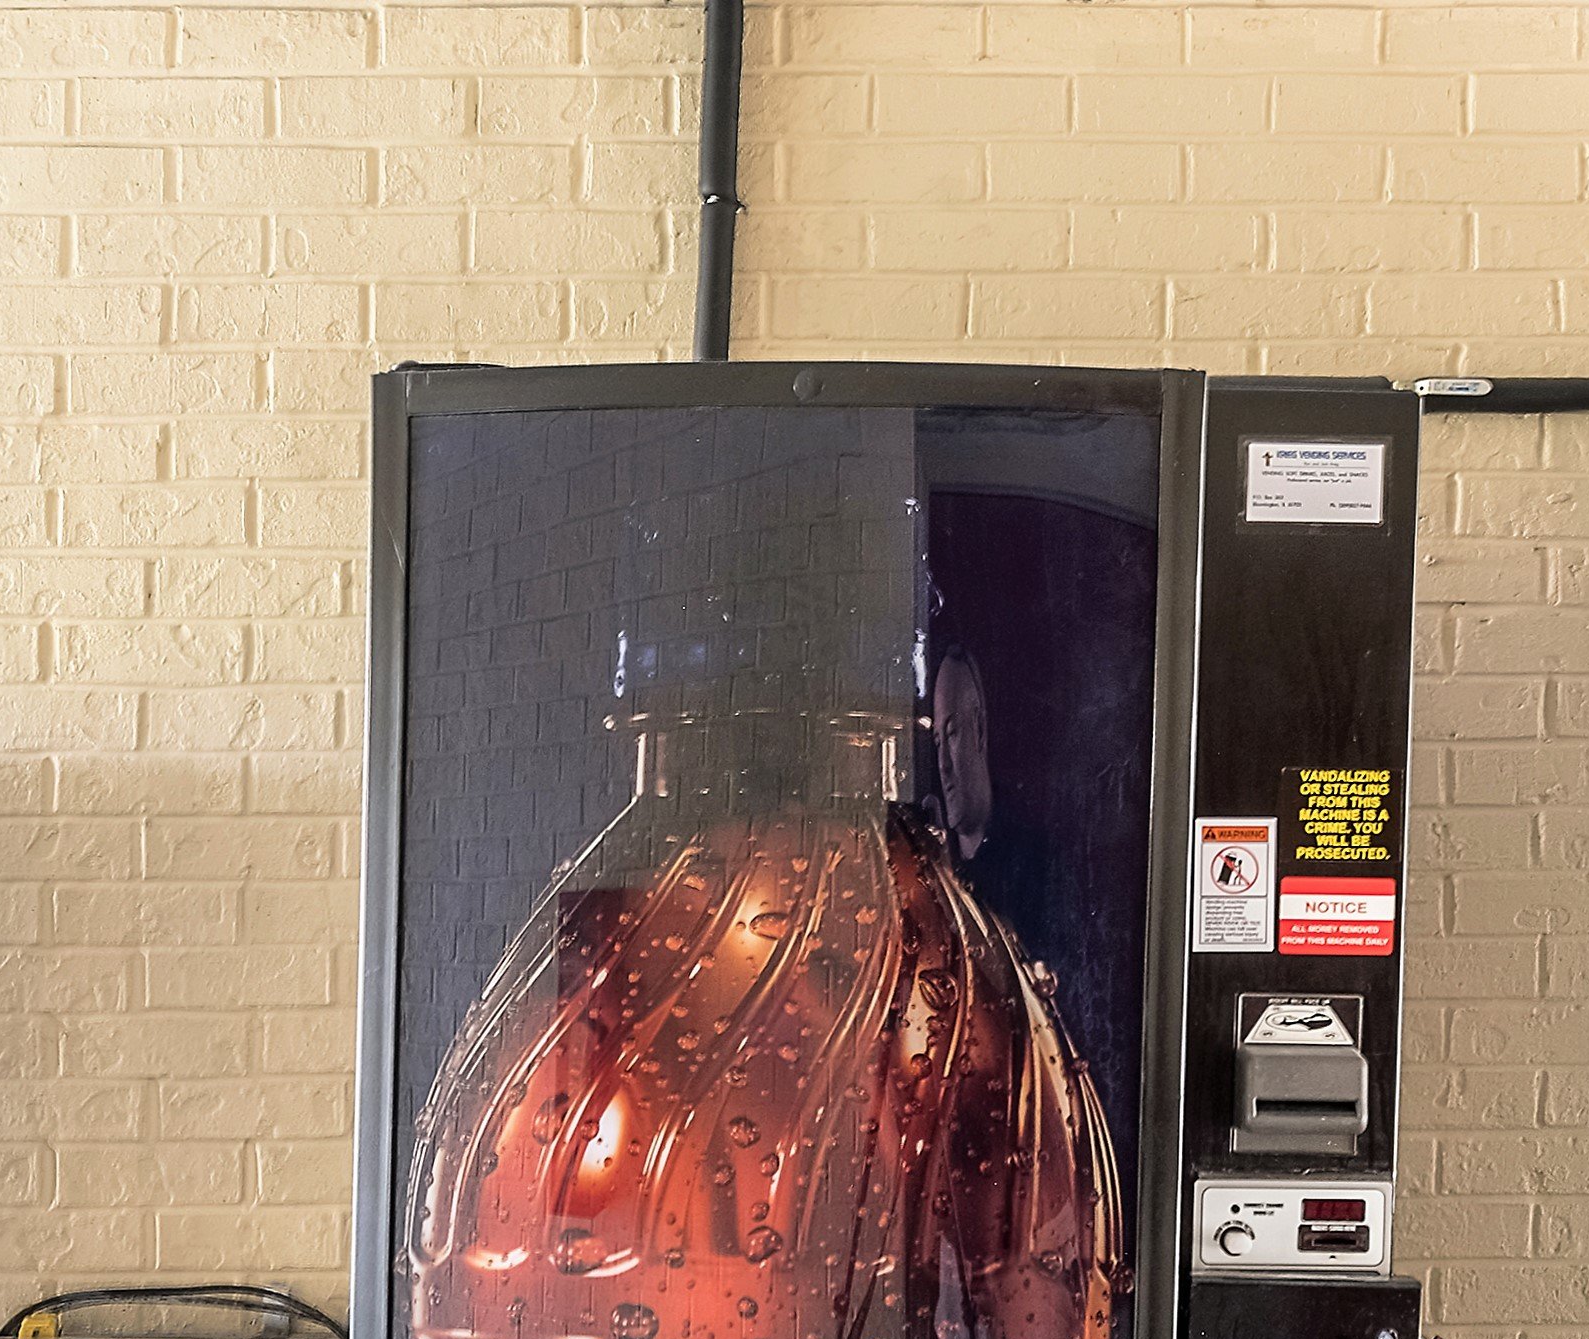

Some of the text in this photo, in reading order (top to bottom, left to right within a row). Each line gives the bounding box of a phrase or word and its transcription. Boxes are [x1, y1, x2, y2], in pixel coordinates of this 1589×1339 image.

[1299, 450, 1330, 460] VENDING
[1331, 451, 1367, 460] SERVICES
[1299, 769, 1390, 783] VANDALIZING
[1299, 783, 1390, 797] OR STEALING
[1308, 796, 1381, 808] FROM THIS
[1299, 809, 1390, 821] MACHINE IS A
[1354, 822, 1383, 834] YOU
[1218, 829, 1266, 840] WARNING
[1316, 834, 1370, 847] WILL BE
[1296, 847, 1391, 861] PROSECUTED.
[1305, 902, 1367, 914] NOTICE
[1291, 925, 1379, 935] ALL MONEY REMOVED
[1281, 936, 1389, 948] FROM THIS MACHINE DAILY
